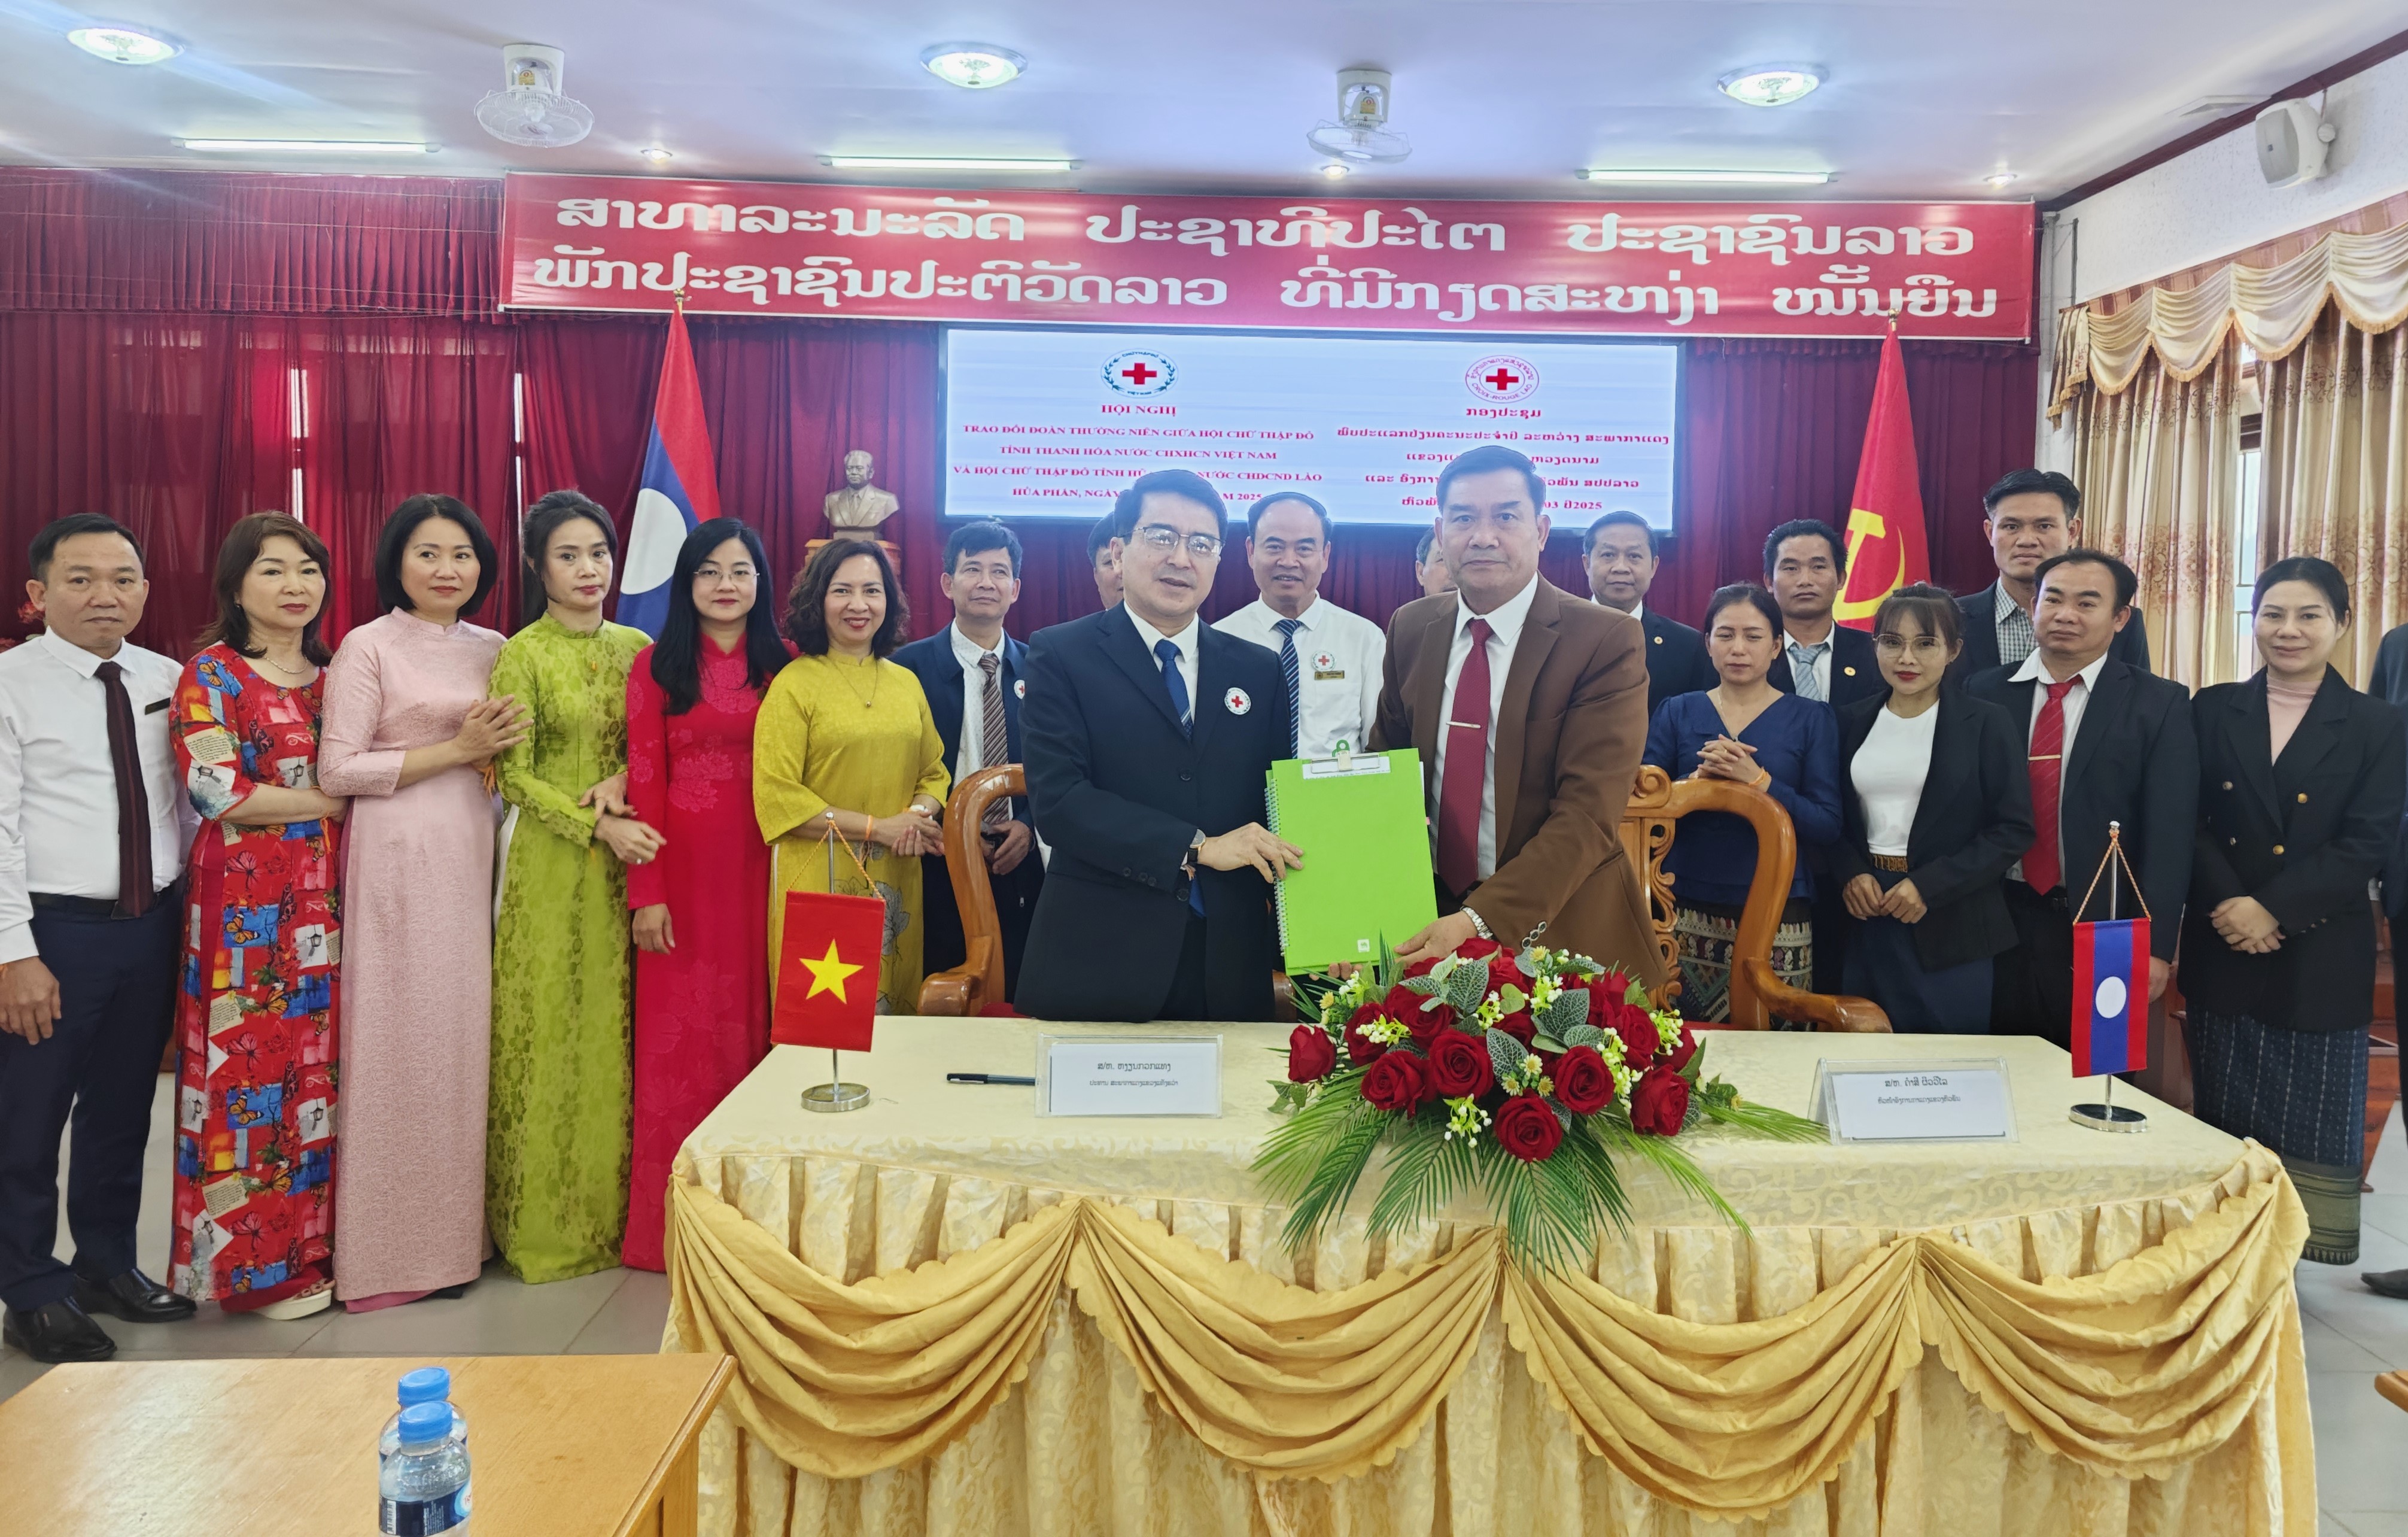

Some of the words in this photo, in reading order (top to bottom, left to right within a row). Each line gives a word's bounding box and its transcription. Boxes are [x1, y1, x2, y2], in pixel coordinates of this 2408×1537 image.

[557, 196, 1025, 242] ສາທາລະນະລັດ
[1086, 203, 1506, 257] ປະຊາທິປະໄຕ
[1567, 212, 1974, 266] ປະຊາຊົນລາວ
[534, 244, 1228, 308] ພັກປະຊາຊົນປະຕິວັດລາວ
[1280, 254, 1719, 326] ທີ່ມີກຽດສະຫງ່າ
[1772, 264, 1997, 318] ໝັ້ນຍືນ
[1101, 403, 1130, 415] HỘI
[1135, 405, 1176, 417] NGHỊ
[1466, 407, 1542, 420] ກອງປະຊຸມ
[963, 424, 998, 433] TRAO
[1029, 425, 1066, 435] ĐOÀN
[1069, 426, 1126, 436] THƯỜNG
[1129, 426, 1160, 436] NIÊN
[1162, 428, 1196, 438] GIỮA
[1199, 429, 1223, 439] HỘI
[1226, 430, 1257, 439] CHỮ
[1260, 430, 1293, 441] THẬP
[1295, 430, 1314, 440] ĐỎ
[1000, 444, 1031, 455] TỈNH
[1035, 446, 1080, 455] THANH
[1083, 446, 1112, 456] HÓA
[1114, 448, 1153, 457] NƯỚC
[1155, 449, 1211, 458] CHXHCN
[1214, 449, 1243, 460] VIỆT
[1247, 451, 1277, 460] NAM
[953, 464, 971, 474] VÀ
[974, 465, 998, 476] HỘI
[1001, 466, 1032, 475] CHỮ
[1035, 466, 1069, 477] THẬP
[1071, 467, 1090, 476] ĐỎ
[1093, 467, 1124, 477] TỈNH
[1197, 470, 1235, 479] NƯỚC
[1237, 472, 1293, 481] CHDCND
[1295, 472, 1322, 481] LÀO
[1365, 475, 1394, 483] ແລະ
[1084, 489, 1120, 498] NGÀY
[1237, 492, 1262, 500] 2025
